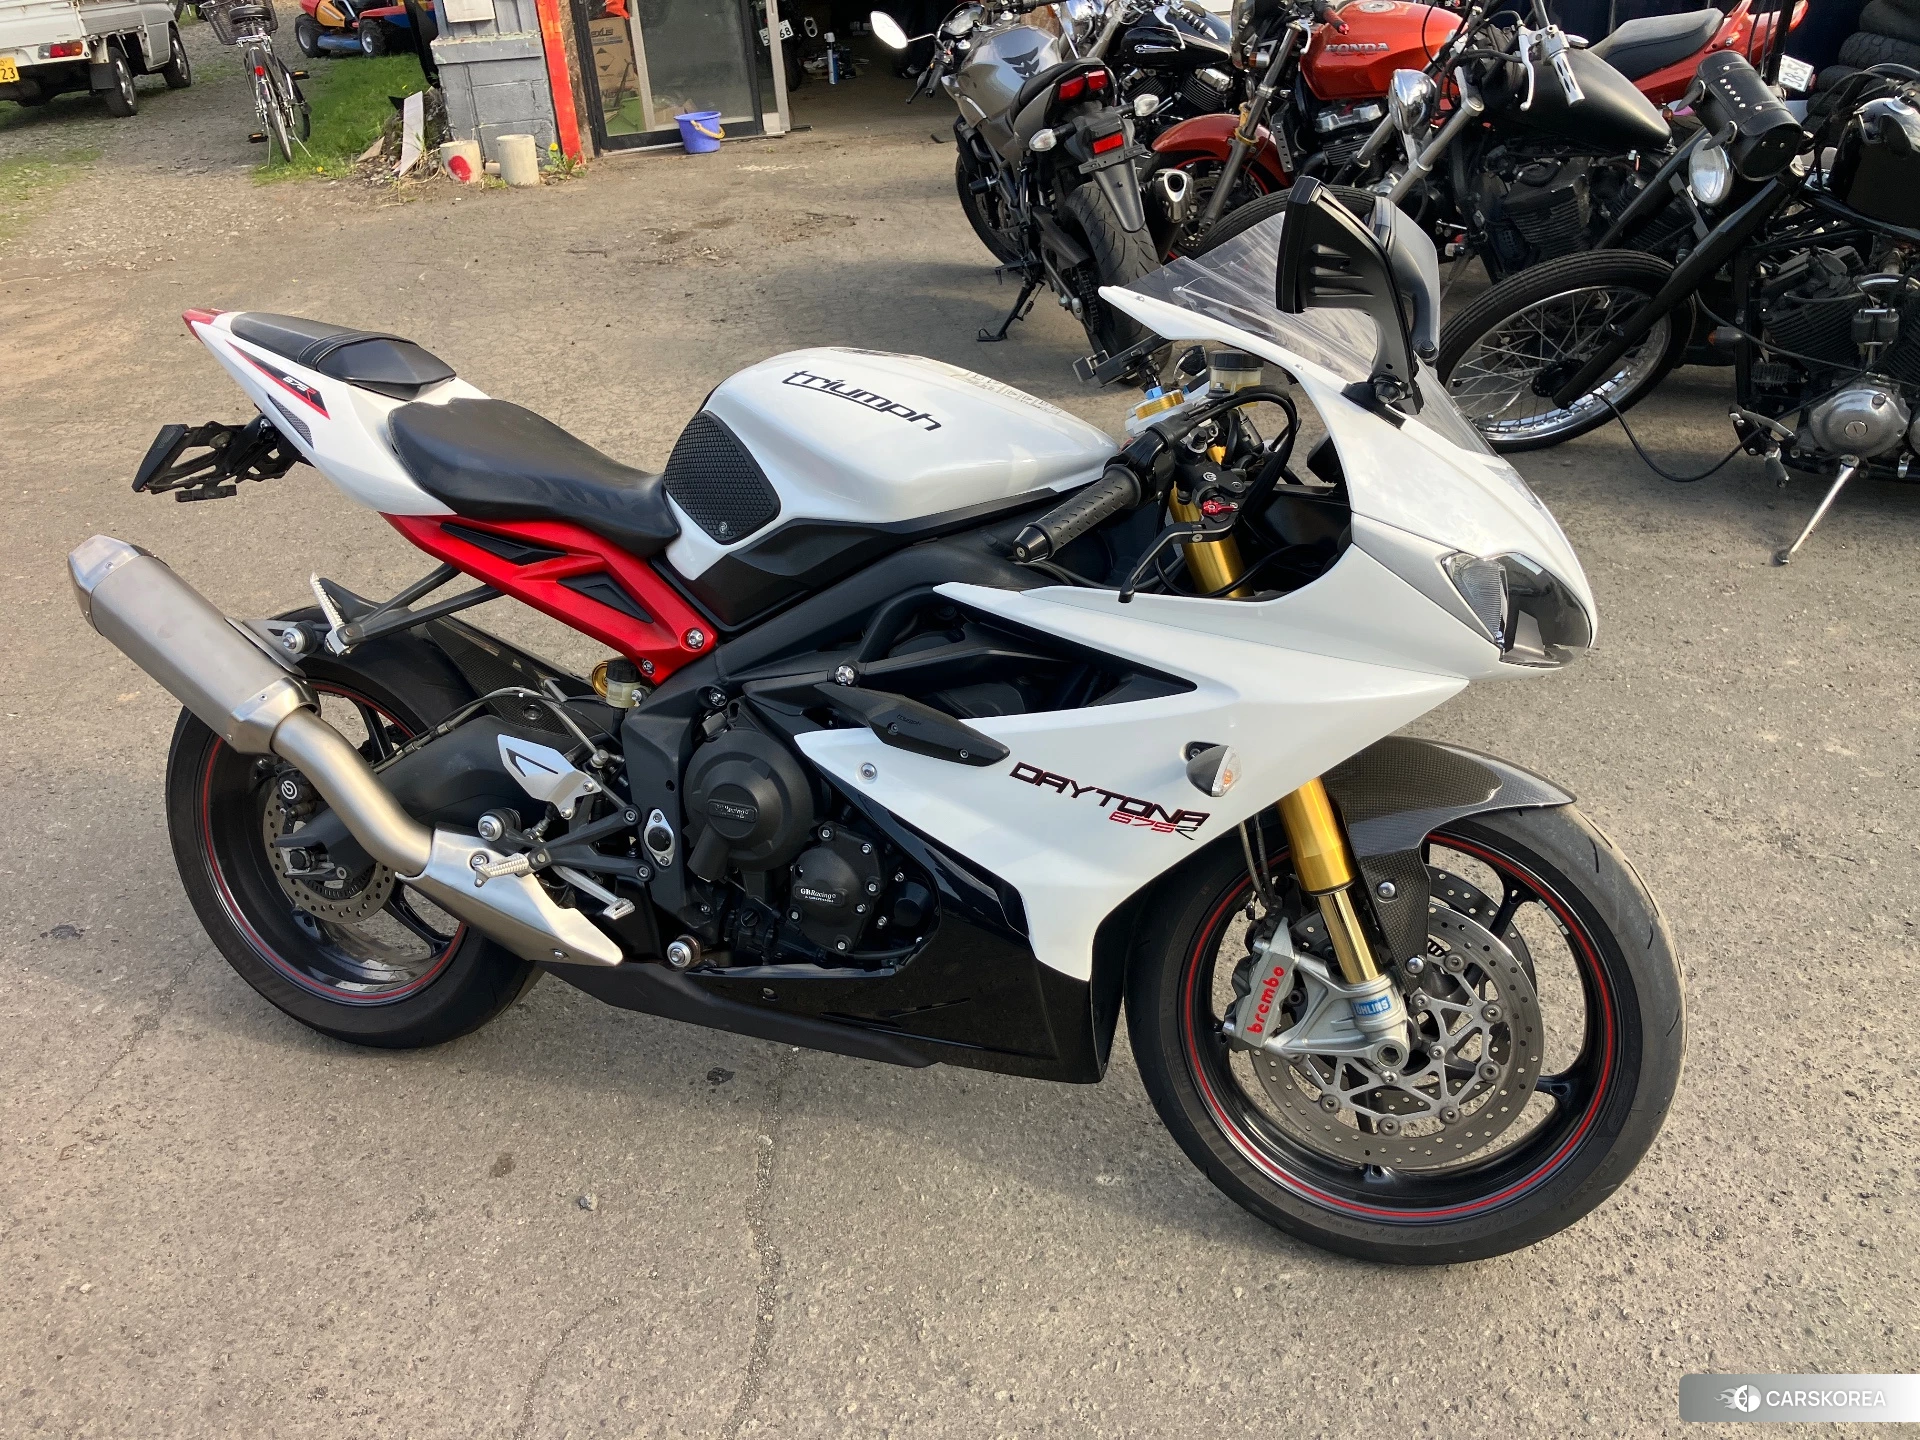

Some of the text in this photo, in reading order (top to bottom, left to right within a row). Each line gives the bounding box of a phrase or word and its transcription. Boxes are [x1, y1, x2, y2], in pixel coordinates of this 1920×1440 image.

[1325, 43, 1390, 52] HONDA
[1009, 761, 1211, 827] DAYTONA
[1108, 811, 1199, 841] 675R
[1246, 966, 1285, 1034] brembo
